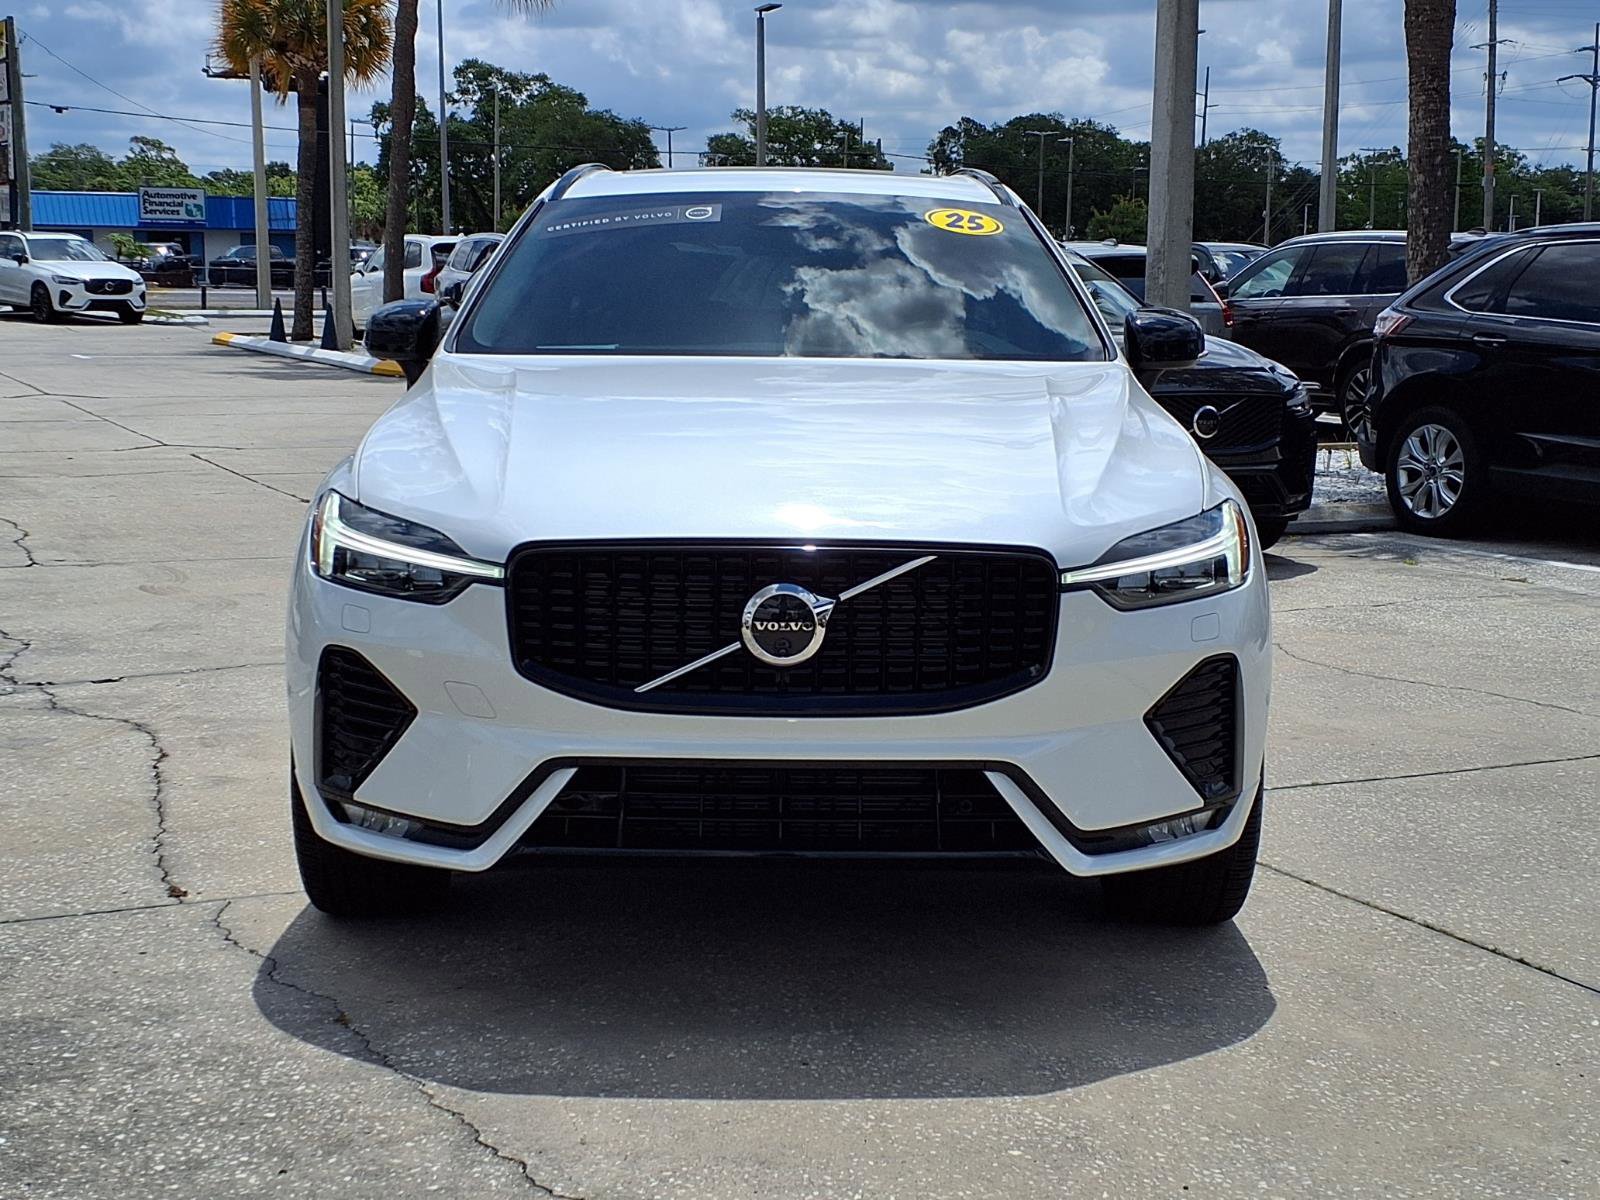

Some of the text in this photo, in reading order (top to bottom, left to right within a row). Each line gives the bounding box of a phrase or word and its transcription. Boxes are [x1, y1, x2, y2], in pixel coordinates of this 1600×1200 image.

[143, 190, 197, 200] Automotive
[143, 198, 183, 207] Financial
[143, 206, 181, 216] Services
[547, 218, 610, 232] CERTIFIED
[634, 212, 672, 221] VOLVO
[945, 212, 985, 231] 25
[753, 621, 814, 631] VOLVO
